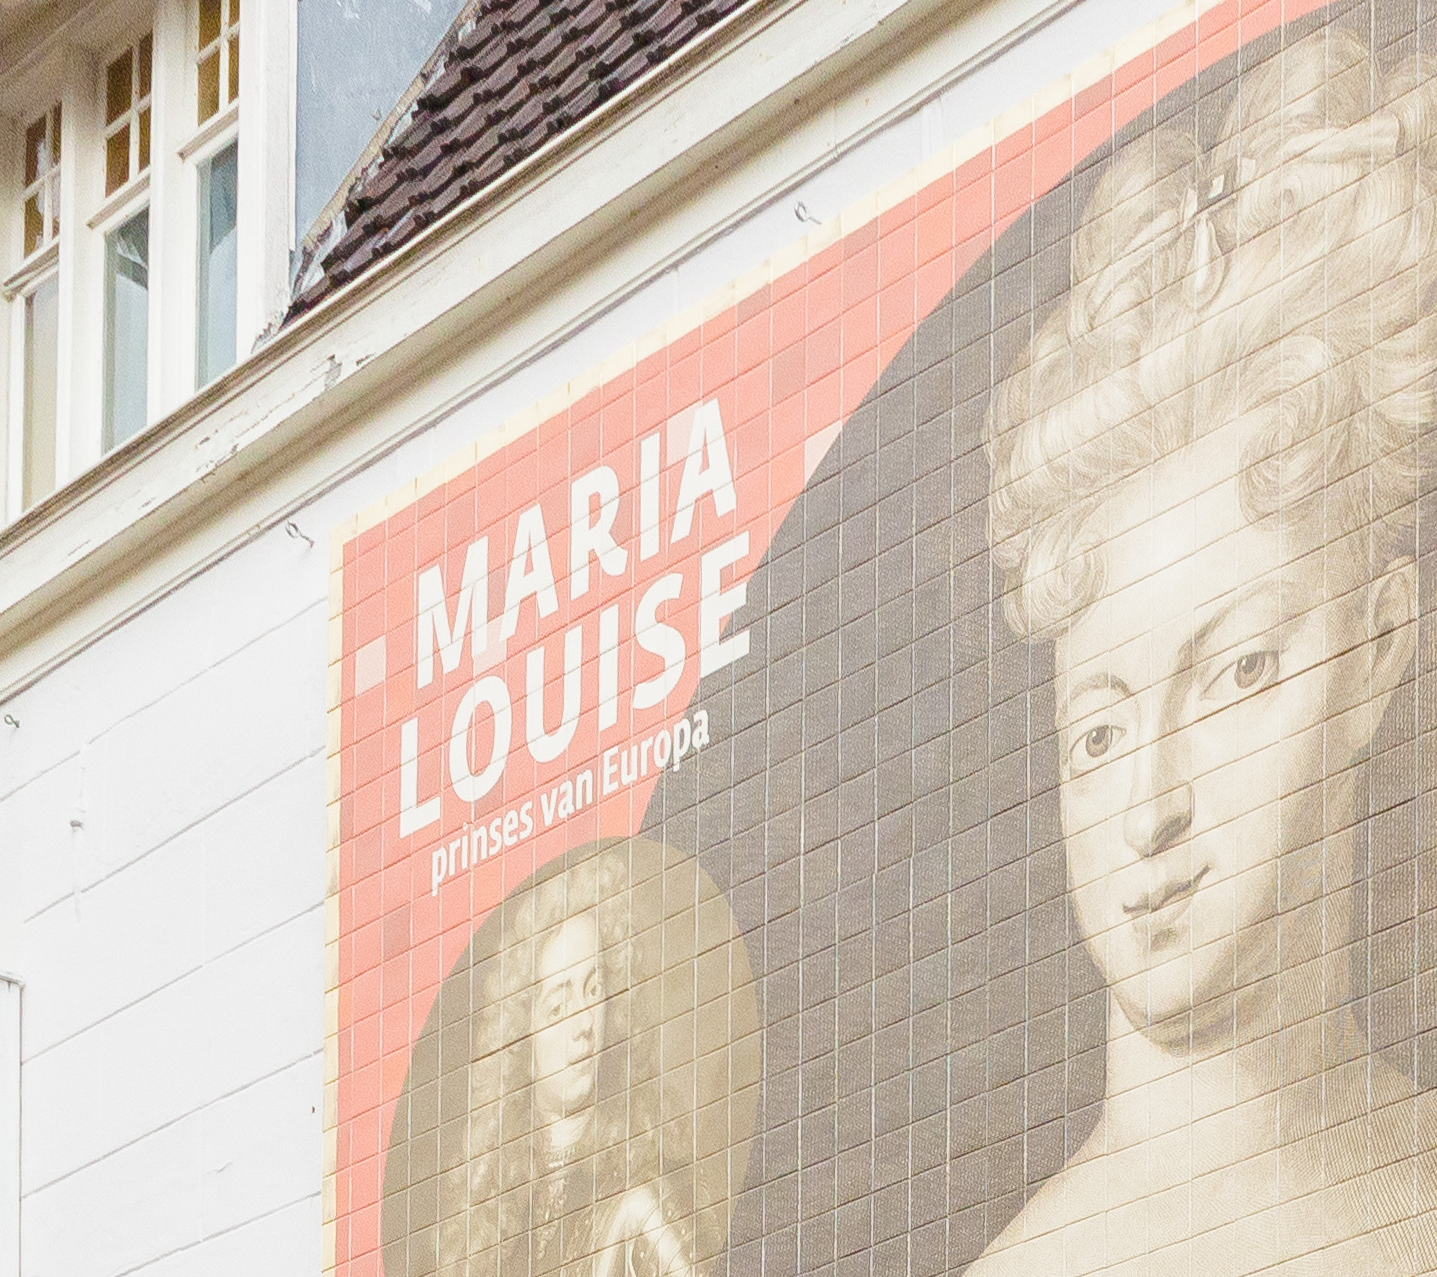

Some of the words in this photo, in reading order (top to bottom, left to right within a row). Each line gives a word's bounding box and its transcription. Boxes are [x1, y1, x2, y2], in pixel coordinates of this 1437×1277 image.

[399, 531, 750, 839] LOUISE
[416, 398, 737, 690] MARIA
[431, 801, 534, 897] prinses
[541, 765, 594, 826] van
[602, 708, 710, 799] Europa
